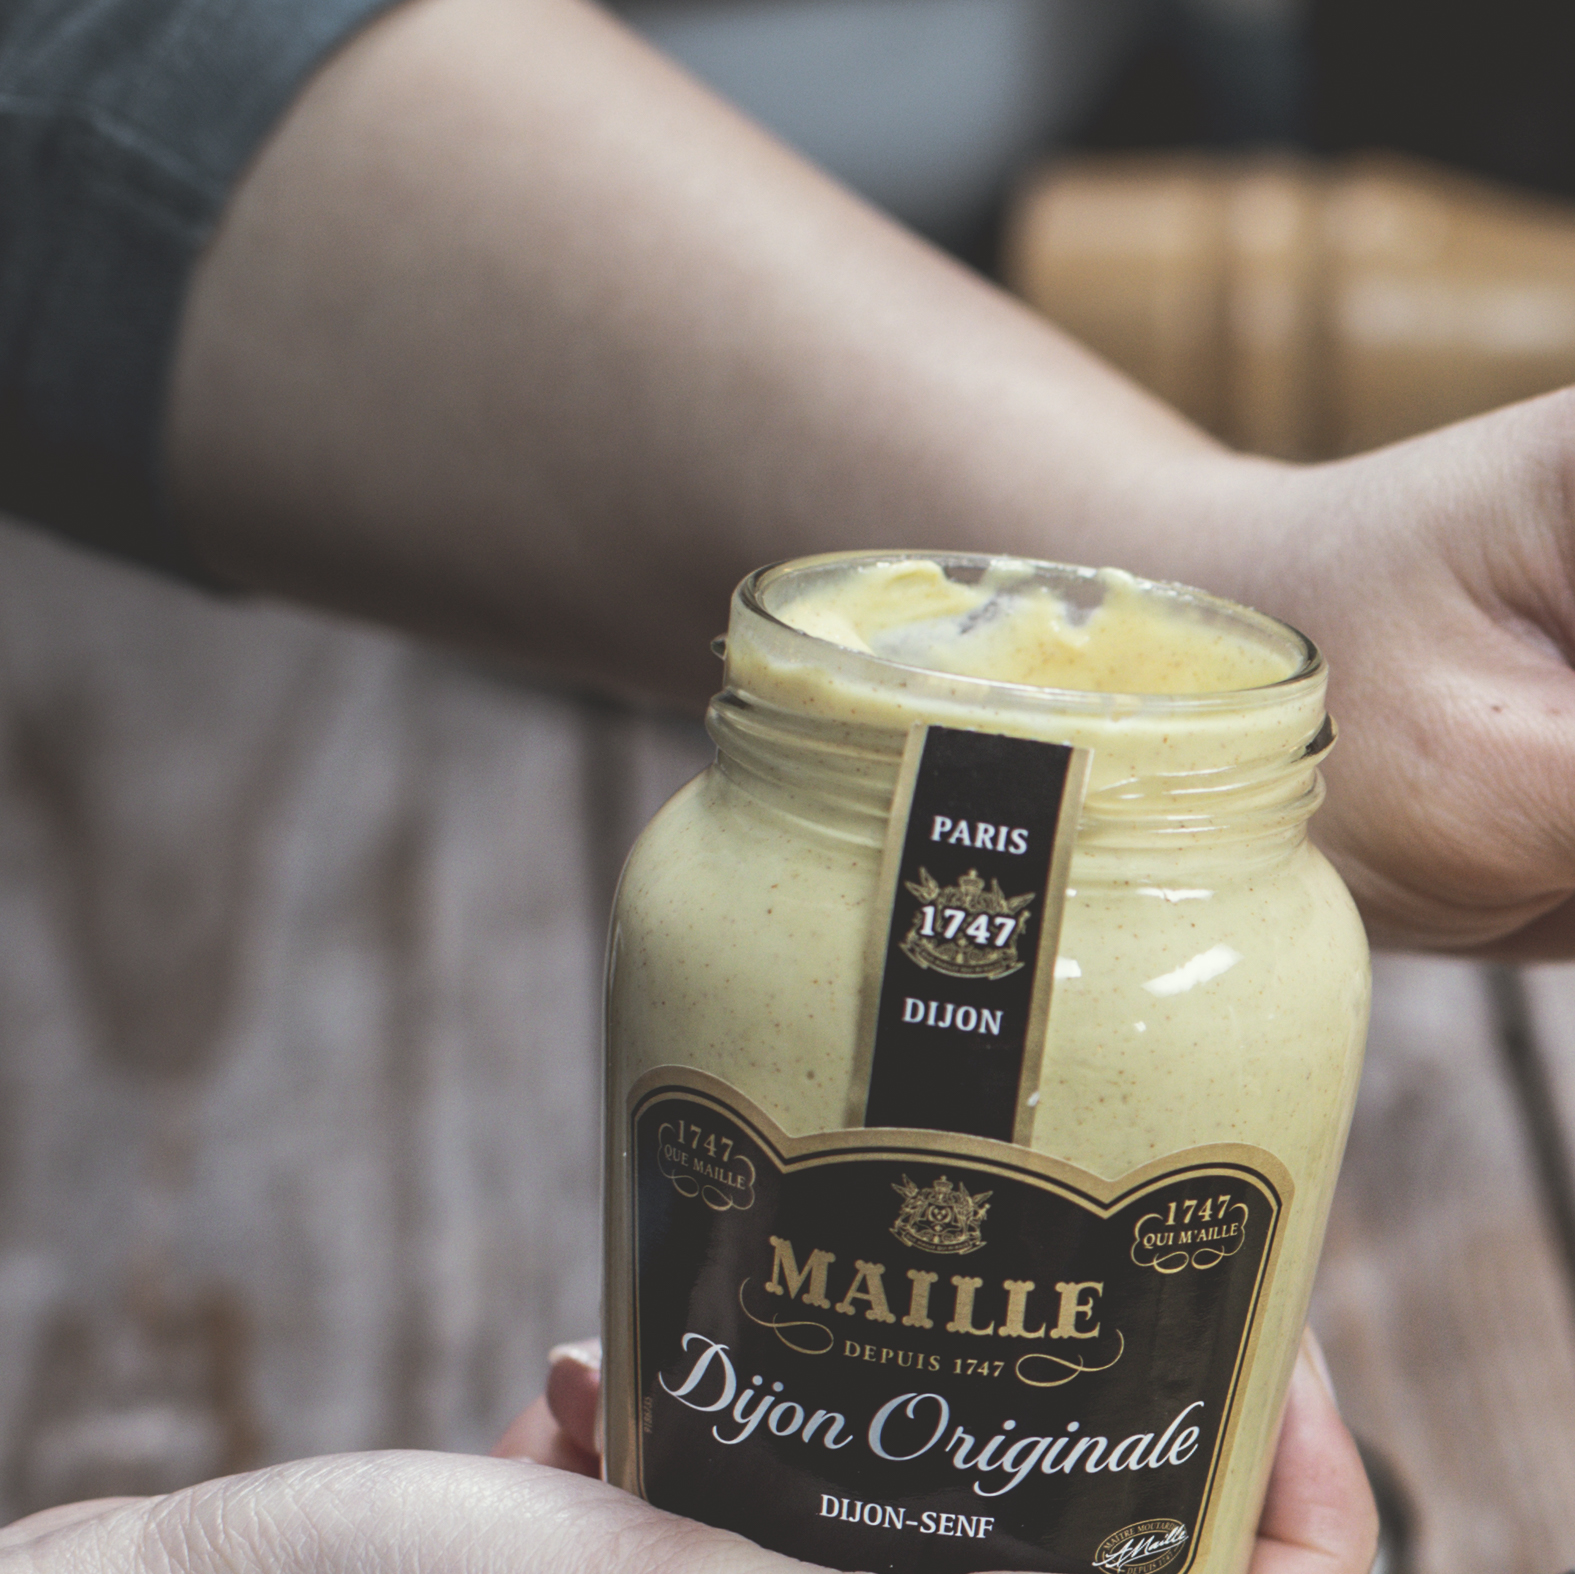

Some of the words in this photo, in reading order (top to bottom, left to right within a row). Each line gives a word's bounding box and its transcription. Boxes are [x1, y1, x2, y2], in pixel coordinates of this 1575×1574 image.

[930, 815, 1029, 855] PARIS
[919, 905, 1017, 947] 1747
[902, 997, 1004, 1035] DIJON
[677, 1119, 734, 1163] 1747
[664, 1143, 690, 1168] QUE
[692, 1157, 747, 1191] MAILLE
[1164, 1194, 1232, 1226] 1747
[1143, 1231, 1175, 1250] QUI
[1178, 1222, 1239, 1245] M'AILLE
[764, 1235, 1105, 1340] MAILLE
[843, 1340, 941, 1372] DEPUIS
[953, 1358, 1005, 1378] 1747
[658, 1332, 854, 1450] Dijon
[868, 1392, 1205, 1497] Originale
[819, 1494, 995, 1539] DIJON-SENF
